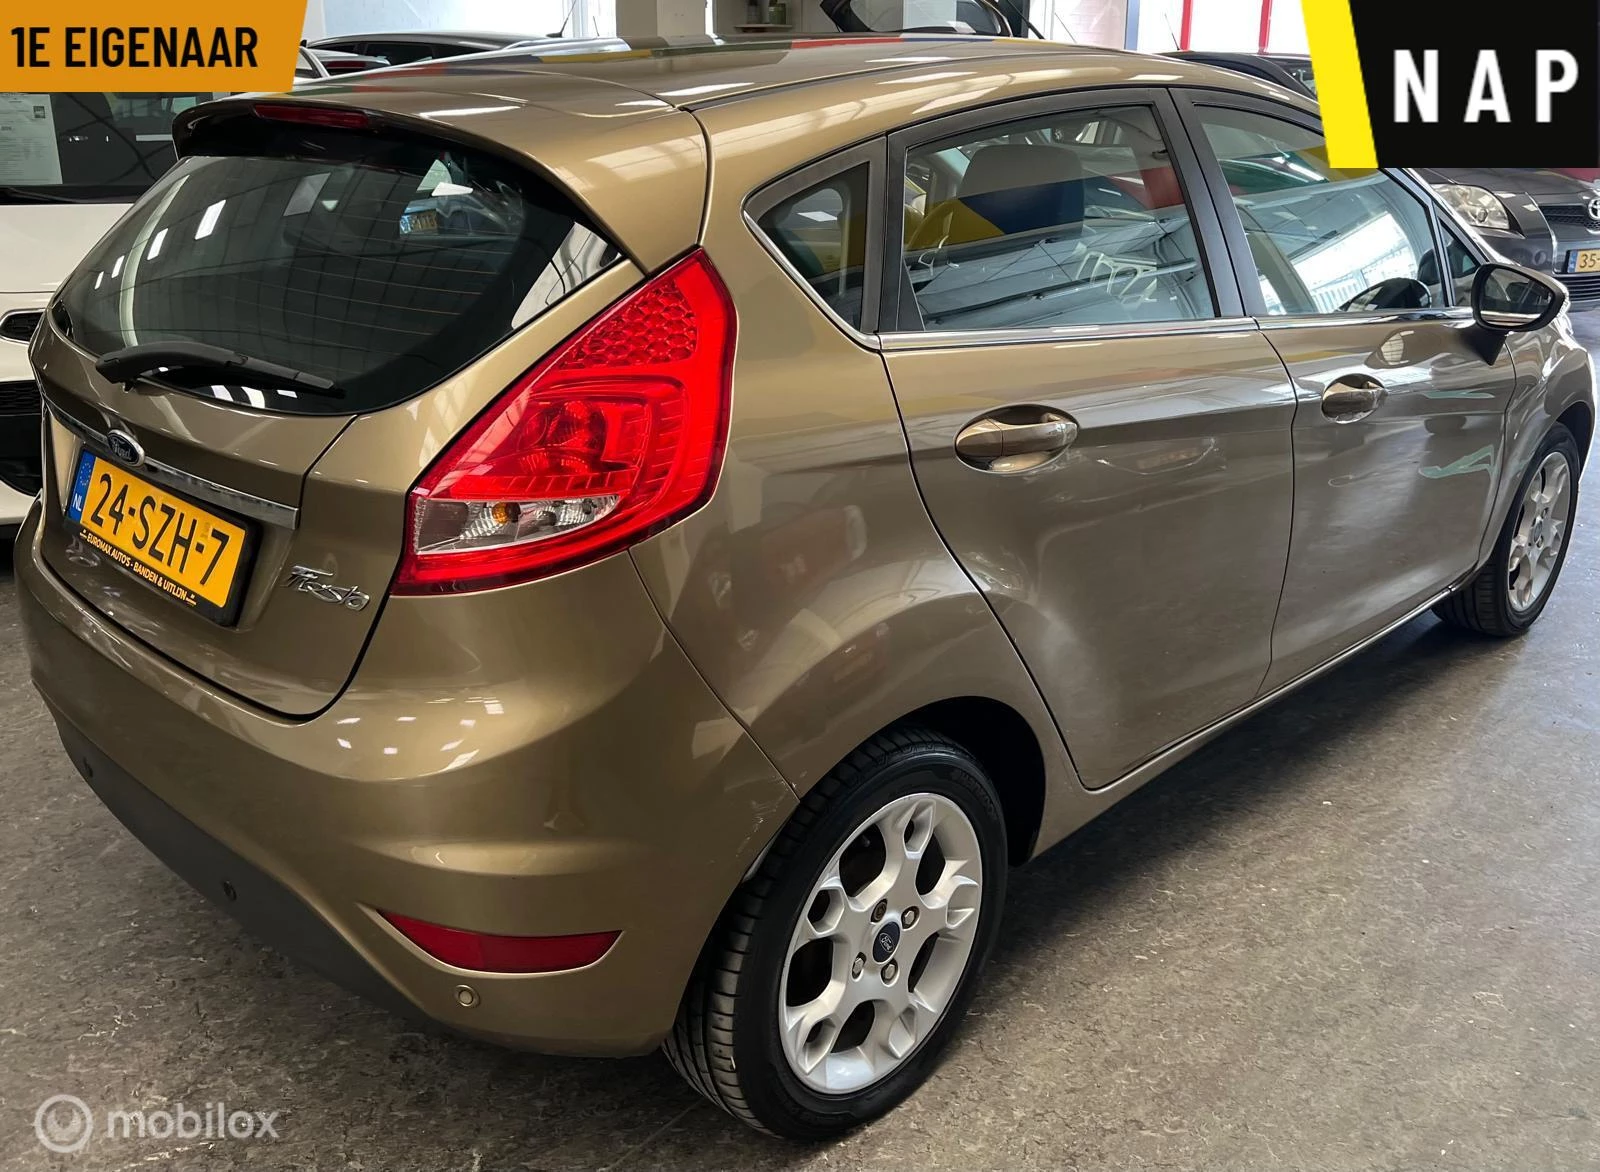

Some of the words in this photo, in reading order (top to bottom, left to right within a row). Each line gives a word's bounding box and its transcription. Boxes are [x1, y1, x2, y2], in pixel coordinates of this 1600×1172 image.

[111, 437, 132, 461] Ford
[72, 493, 82, 512] NL
[91, 473, 230, 586] 24-SZH-7
[86, 532, 112, 554] EUROMAX
[133, 562, 158, 584] BANDEN
